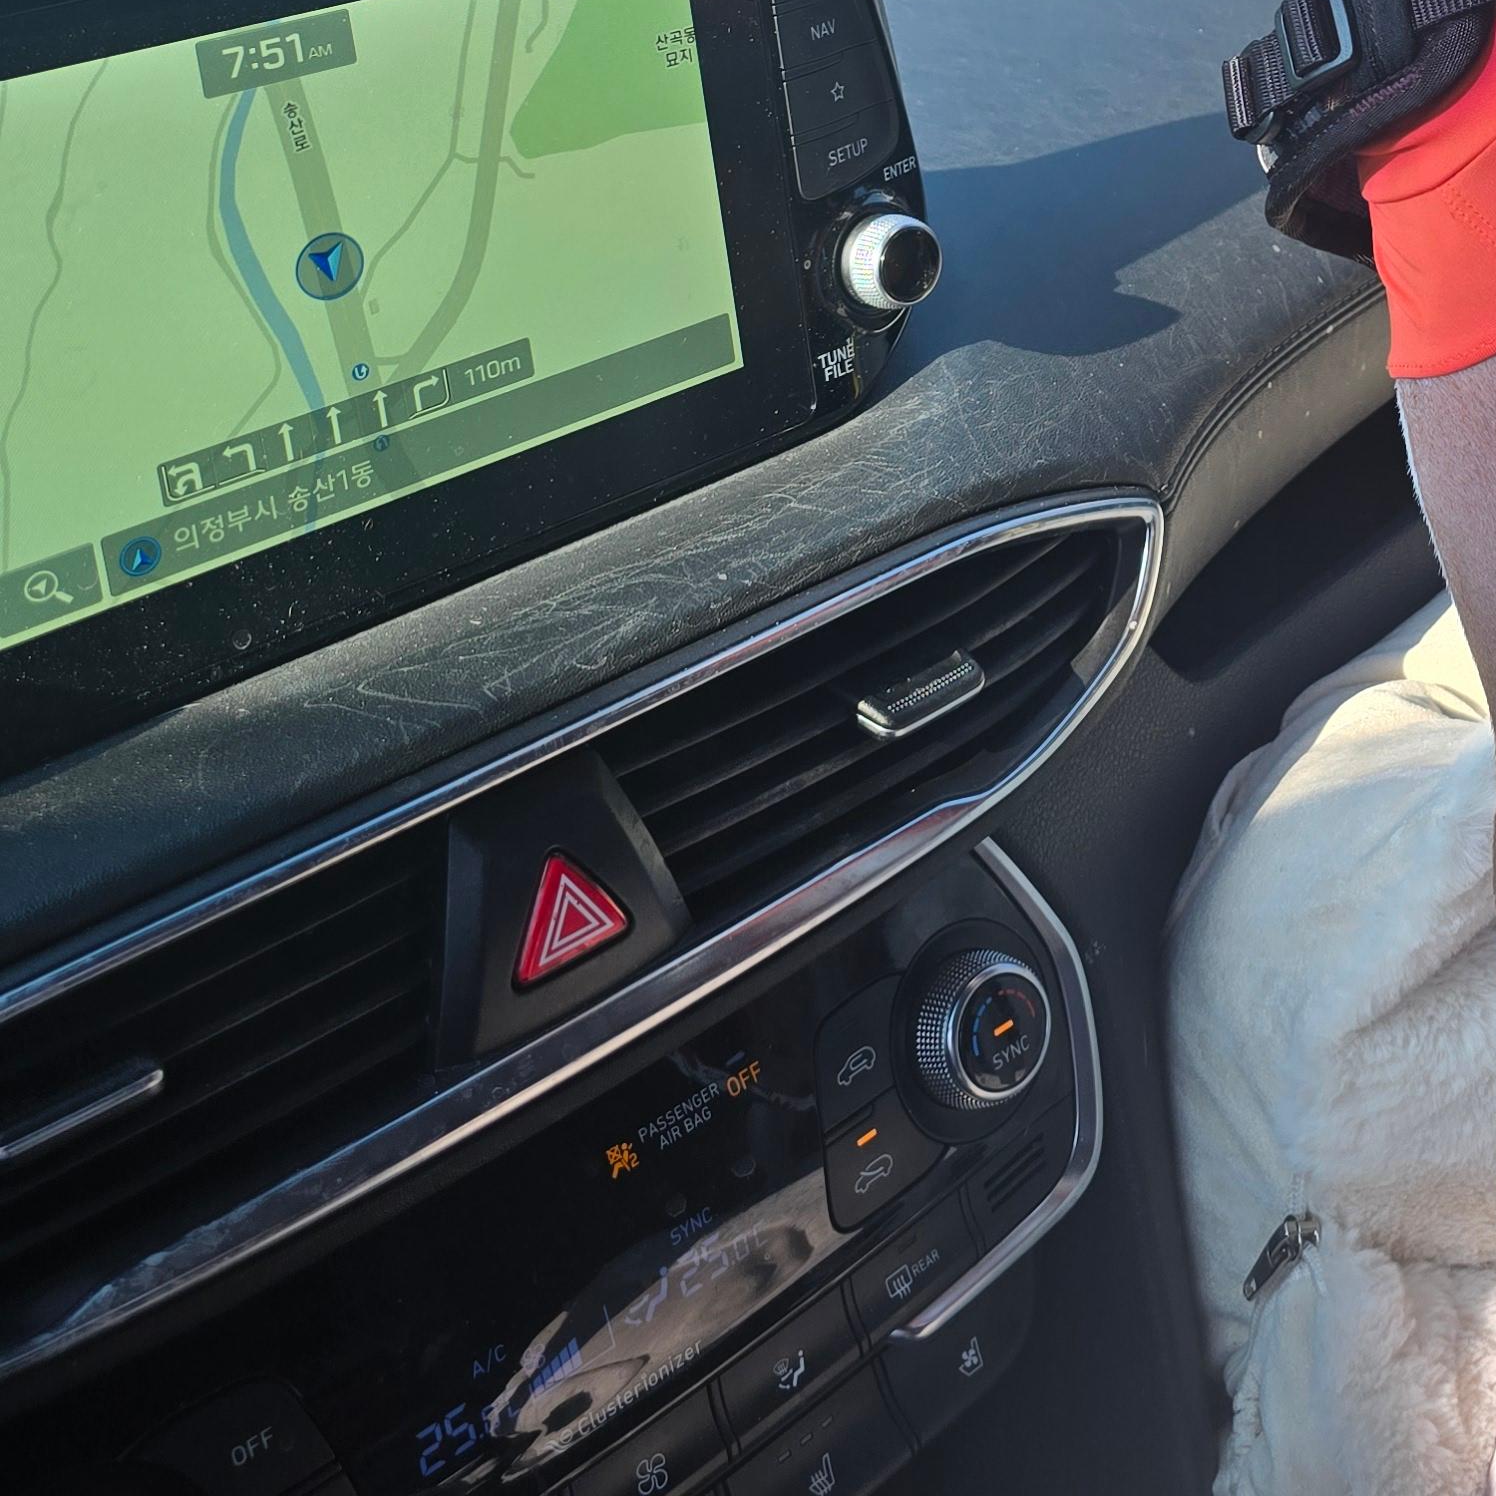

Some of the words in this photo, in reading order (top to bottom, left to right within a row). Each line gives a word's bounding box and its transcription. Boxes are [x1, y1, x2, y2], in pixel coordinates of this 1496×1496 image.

[655, 26, 696, 52] 산곡동
[810, 18, 837, 41] NAV
[221, 32, 304, 79] 7:51
[308, 43, 333, 60] AM
[665, 47, 693, 68] 묘지
[283, 101, 311, 153] 송산로
[828, 138, 869, 167] SETUP
[883, 156, 917, 183] ENTER
[464, 356, 521, 386] 110m
[817, 344, 855, 369] TUNE
[824, 359, 854, 382] FILE
[173, 494, 278, 552] 의정부시
[287, 459, 375, 513] 송산1동
[992, 1034, 1031, 1071] SYNC
[726, 1060, 761, 1097] OFF
[637, 1082, 721, 1144] PASSENGER
[659, 1125, 683, 1150] AIR
[684, 1106, 712, 1134] BAG
[669, 1206, 713, 1246] SYNC
[911, 1248, 940, 1277] REAR
[472, 1344, 507, 1380] A/C
[577, 1339, 702, 1437] Clusterionizer
[231, 1426, 273, 1466] OFF
